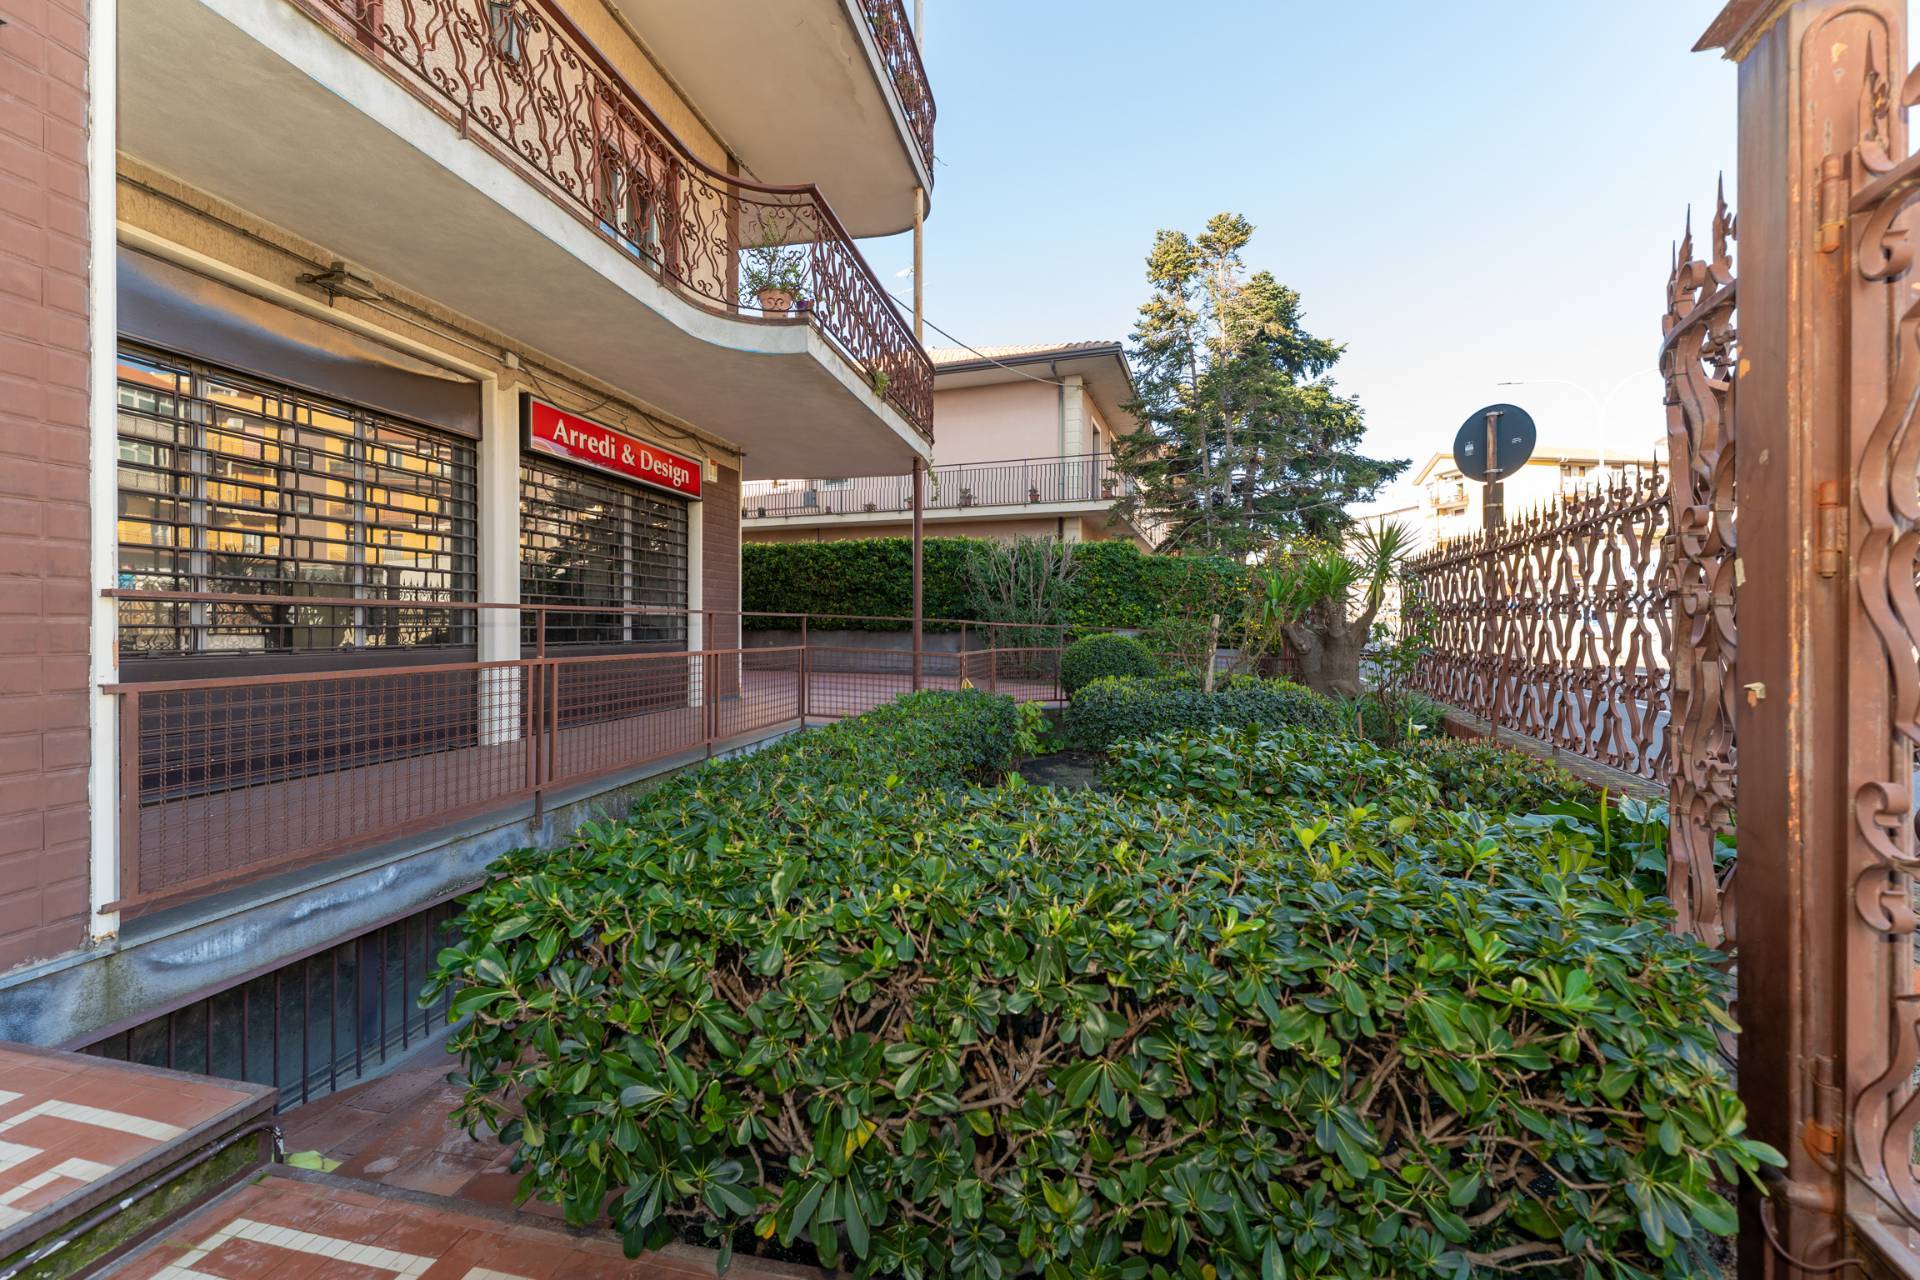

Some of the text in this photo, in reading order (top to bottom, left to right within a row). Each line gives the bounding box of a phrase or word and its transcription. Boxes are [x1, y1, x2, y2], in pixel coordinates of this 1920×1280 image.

[553, 418, 690, 487] Arredi & Design
